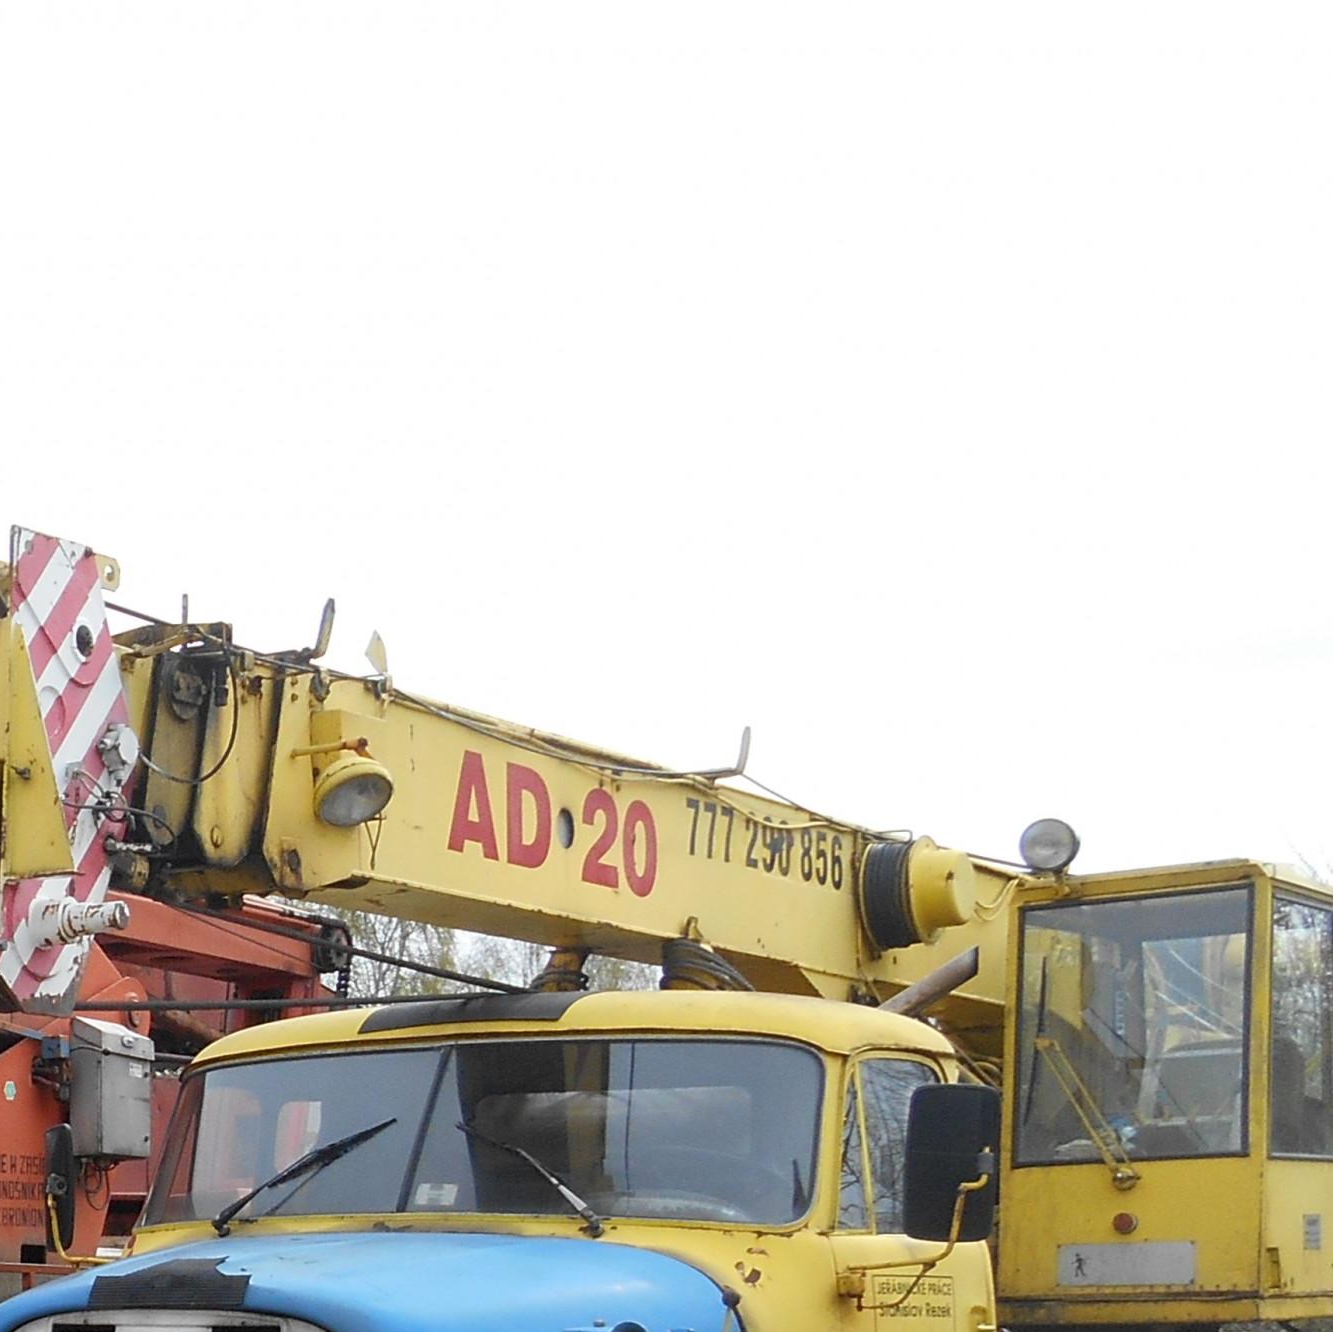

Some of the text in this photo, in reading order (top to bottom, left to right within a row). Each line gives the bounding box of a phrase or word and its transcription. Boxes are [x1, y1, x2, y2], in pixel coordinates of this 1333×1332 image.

[447, 749, 658, 898] AD 20
[686, 797, 733, 863] 777
[800, 829, 844, 891] 856
